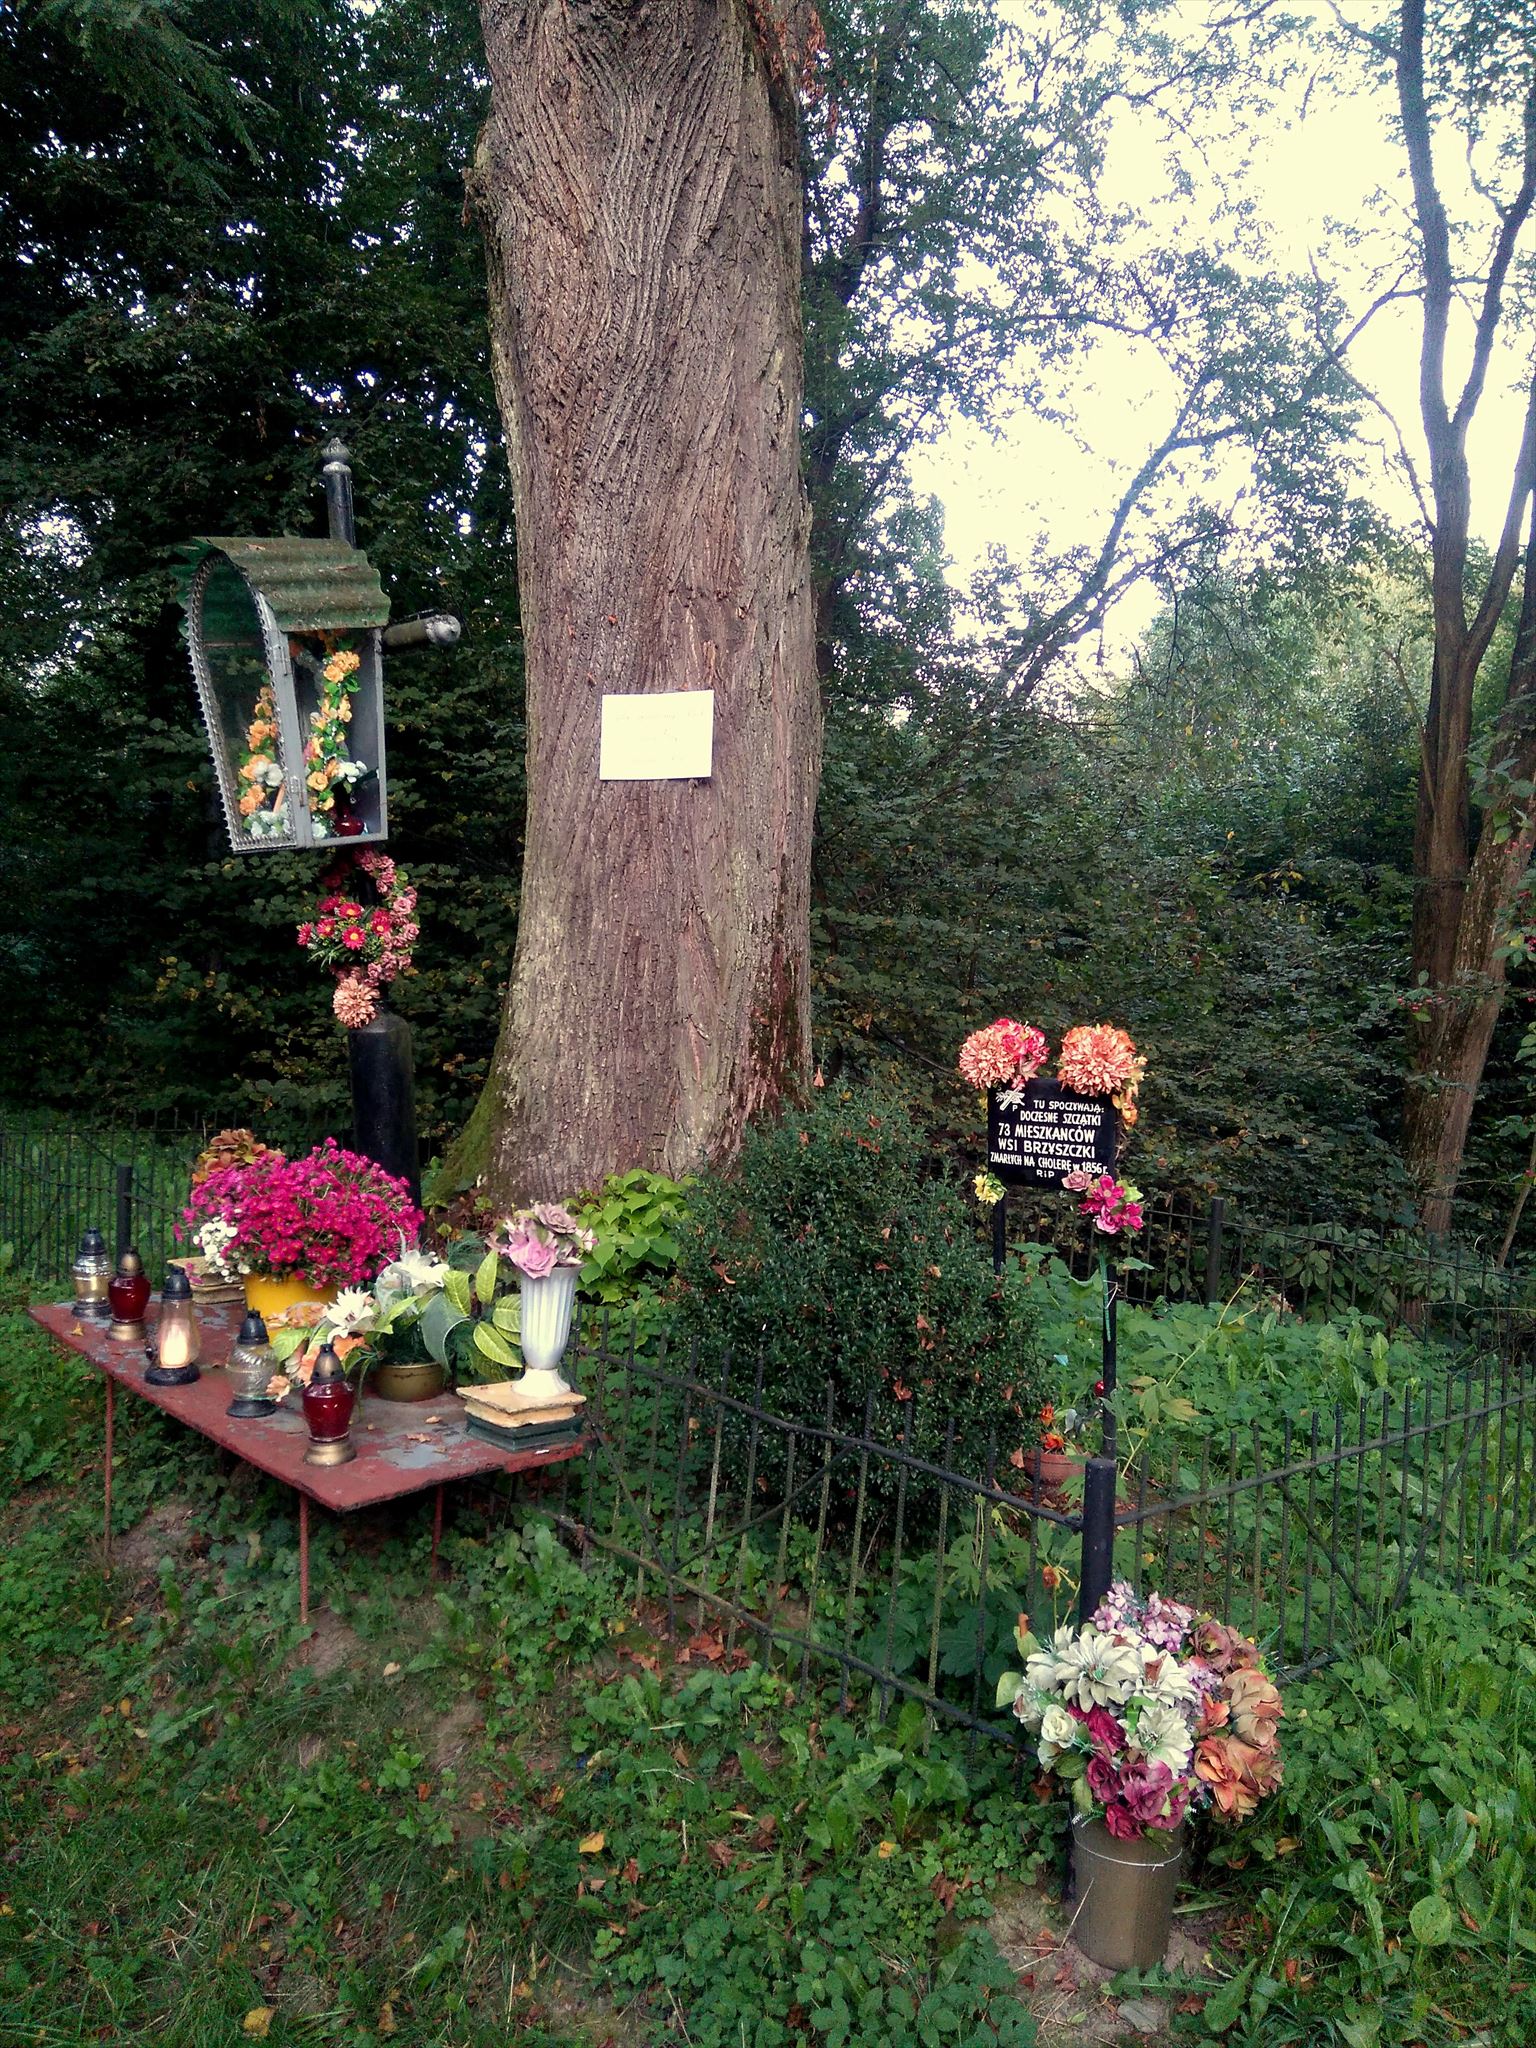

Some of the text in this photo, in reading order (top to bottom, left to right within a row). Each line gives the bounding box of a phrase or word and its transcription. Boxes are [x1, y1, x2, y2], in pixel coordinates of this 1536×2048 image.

[1033, 1099, 1045, 1109] TU
[1020, 1110, 1101, 1127] DOCZESNE SZCZĄTKI
[998, 1123, 1010, 1136] 73
[998, 1138, 1096, 1158] WSI BRZYSZCZKI
[990, 1151, 1022, 1166] ZMARŁYCH
[1024, 1156, 1035, 1167] NA
[1038, 1157, 1072, 1173] CHOLERĘ
